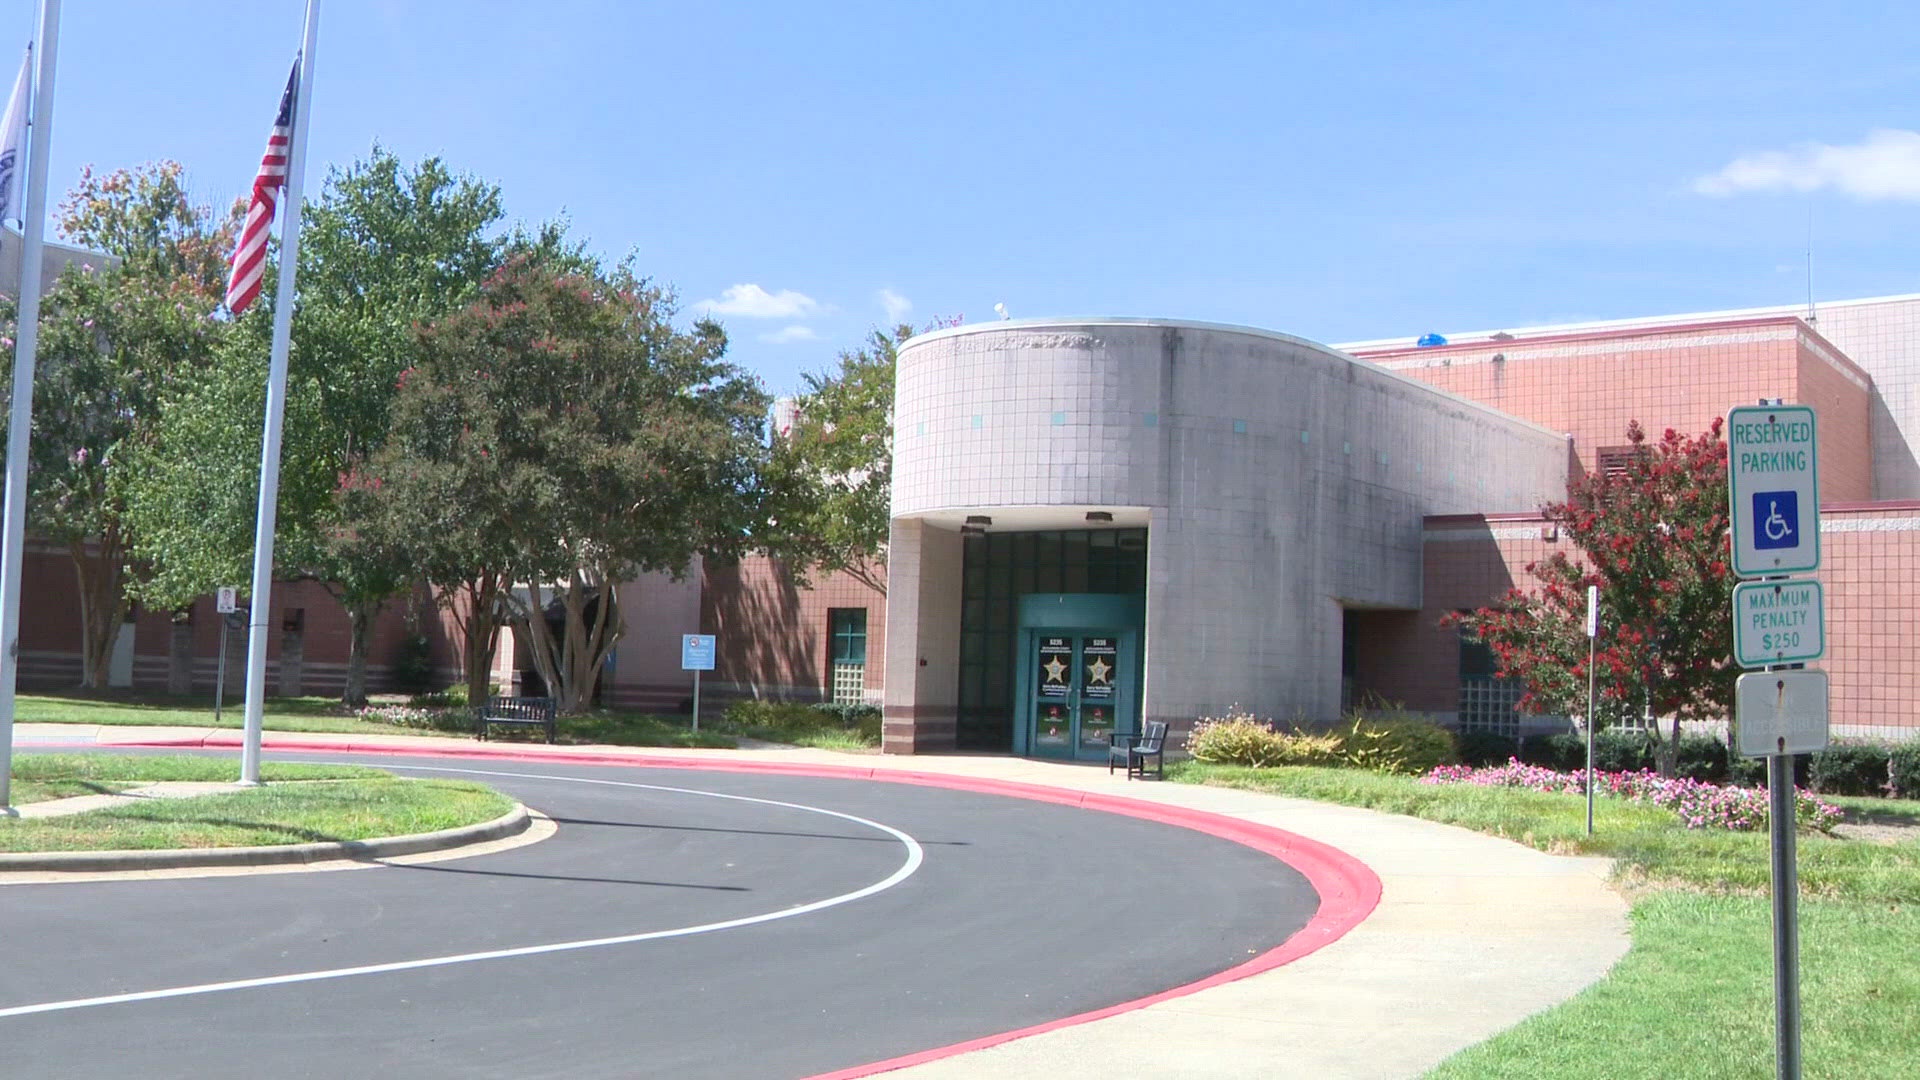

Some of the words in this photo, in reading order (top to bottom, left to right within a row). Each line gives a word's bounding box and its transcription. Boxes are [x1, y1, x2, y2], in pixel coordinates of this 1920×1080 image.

[1736, 423, 1810, 444] RESERVED
[1741, 450, 1806, 474] PARKING
[1749, 590, 1810, 609] MAXIMUM
[1752, 610, 1807, 630] PENALTY
[1762, 631, 1800, 651] $250
